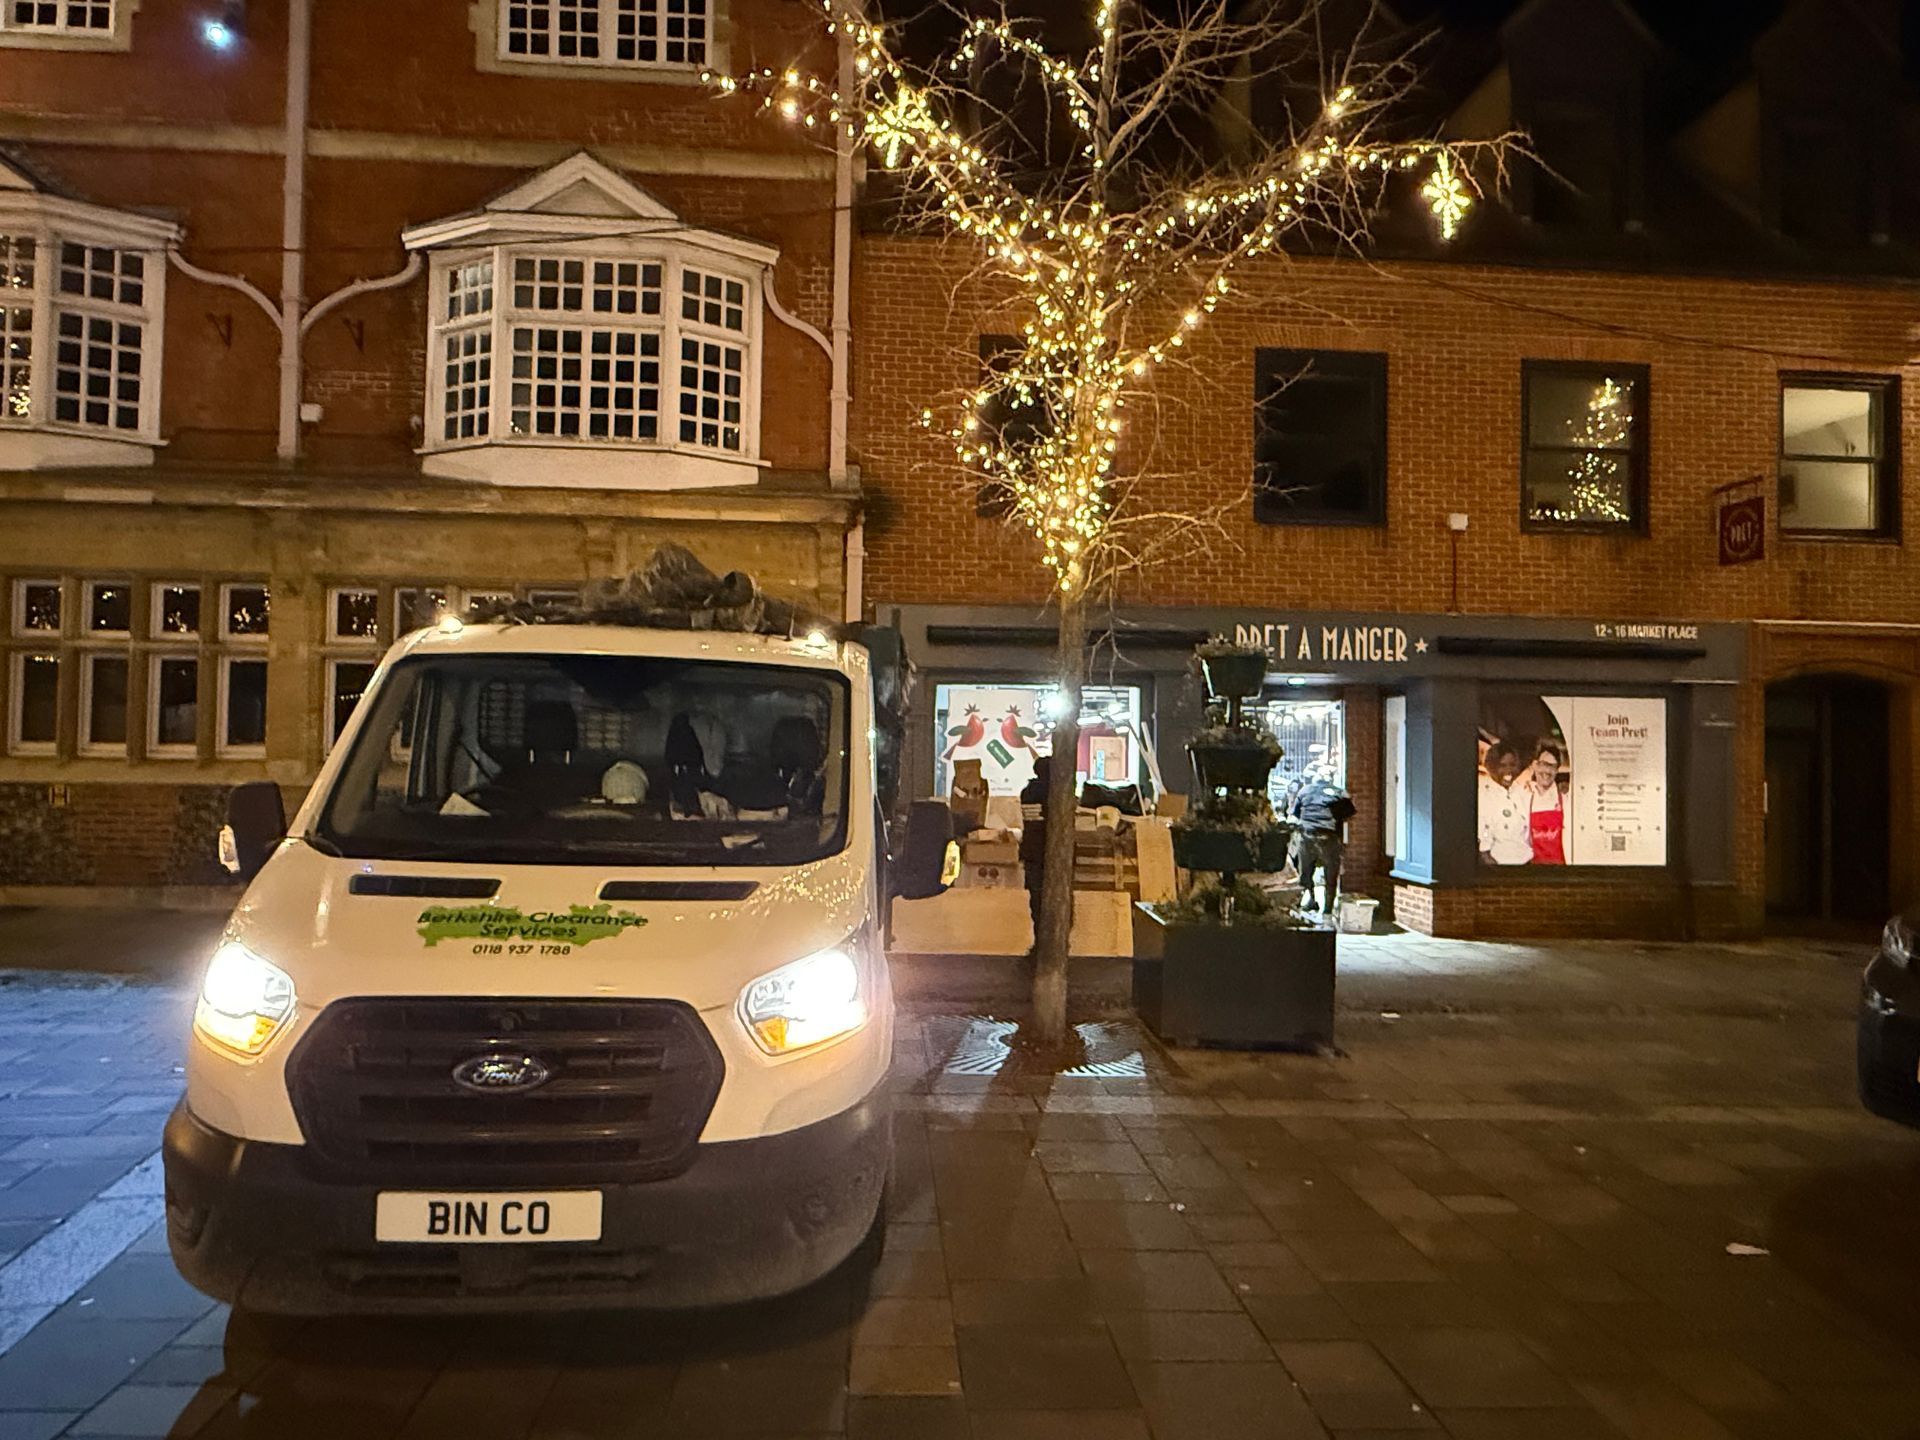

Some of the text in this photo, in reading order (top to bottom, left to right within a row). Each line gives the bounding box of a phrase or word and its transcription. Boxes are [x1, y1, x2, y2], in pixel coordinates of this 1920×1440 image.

[1627, 624, 1667, 638] MARKET
[1667, 625, 1698, 639] PLACE
[1297, 626, 1312, 661] A
[1322, 626, 1409, 662] MANGER
[1607, 714, 1629, 726] Join
[1589, 726, 1619, 738] Team
[417, 910, 649, 927] Berkshire Clearance
[480, 923, 577, 937] Services
[472, 944, 571, 955] 0118 937 1788
[472, 1061, 527, 1085] Ford
